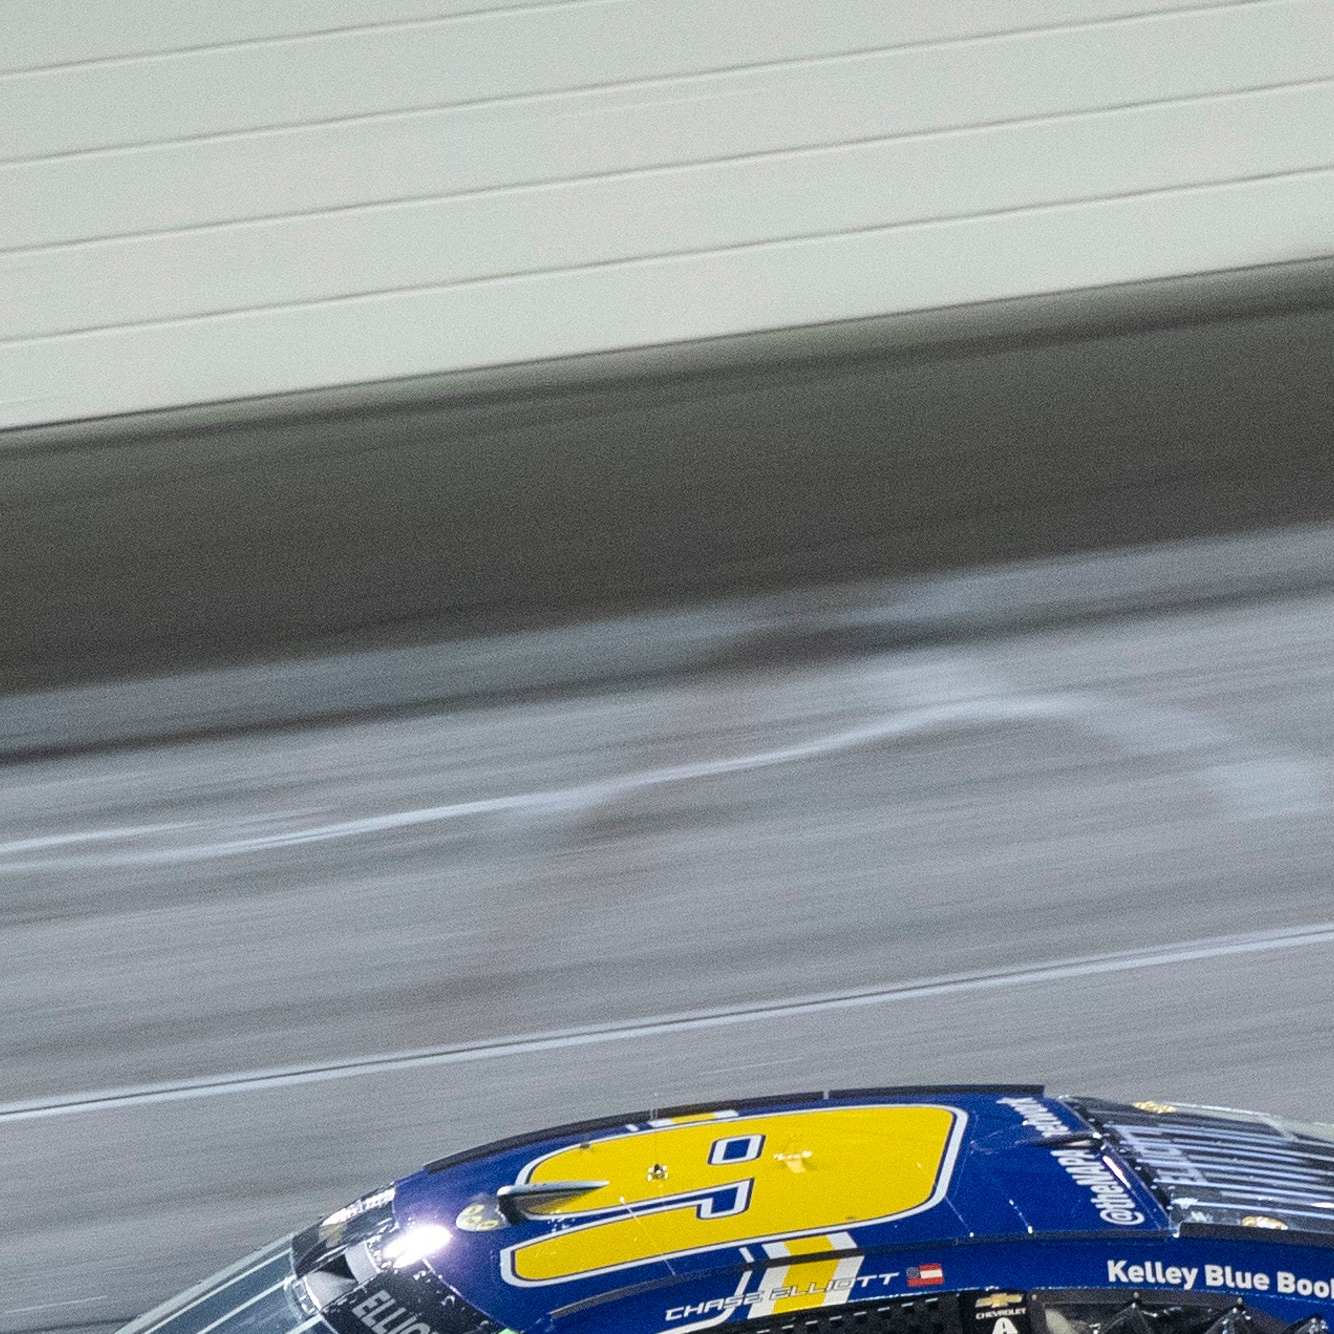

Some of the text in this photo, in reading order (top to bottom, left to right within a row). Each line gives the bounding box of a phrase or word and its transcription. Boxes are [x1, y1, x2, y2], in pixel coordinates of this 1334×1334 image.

[500, 1104, 968, 1287] 9
[1107, 1259, 1198, 1290] Kelley
[1204, 1264, 1270, 1290] Blue
[665, 1271, 900, 1321] CHASE ELLIOTT
[975, 1308, 1026, 1320] CHEVROLET
